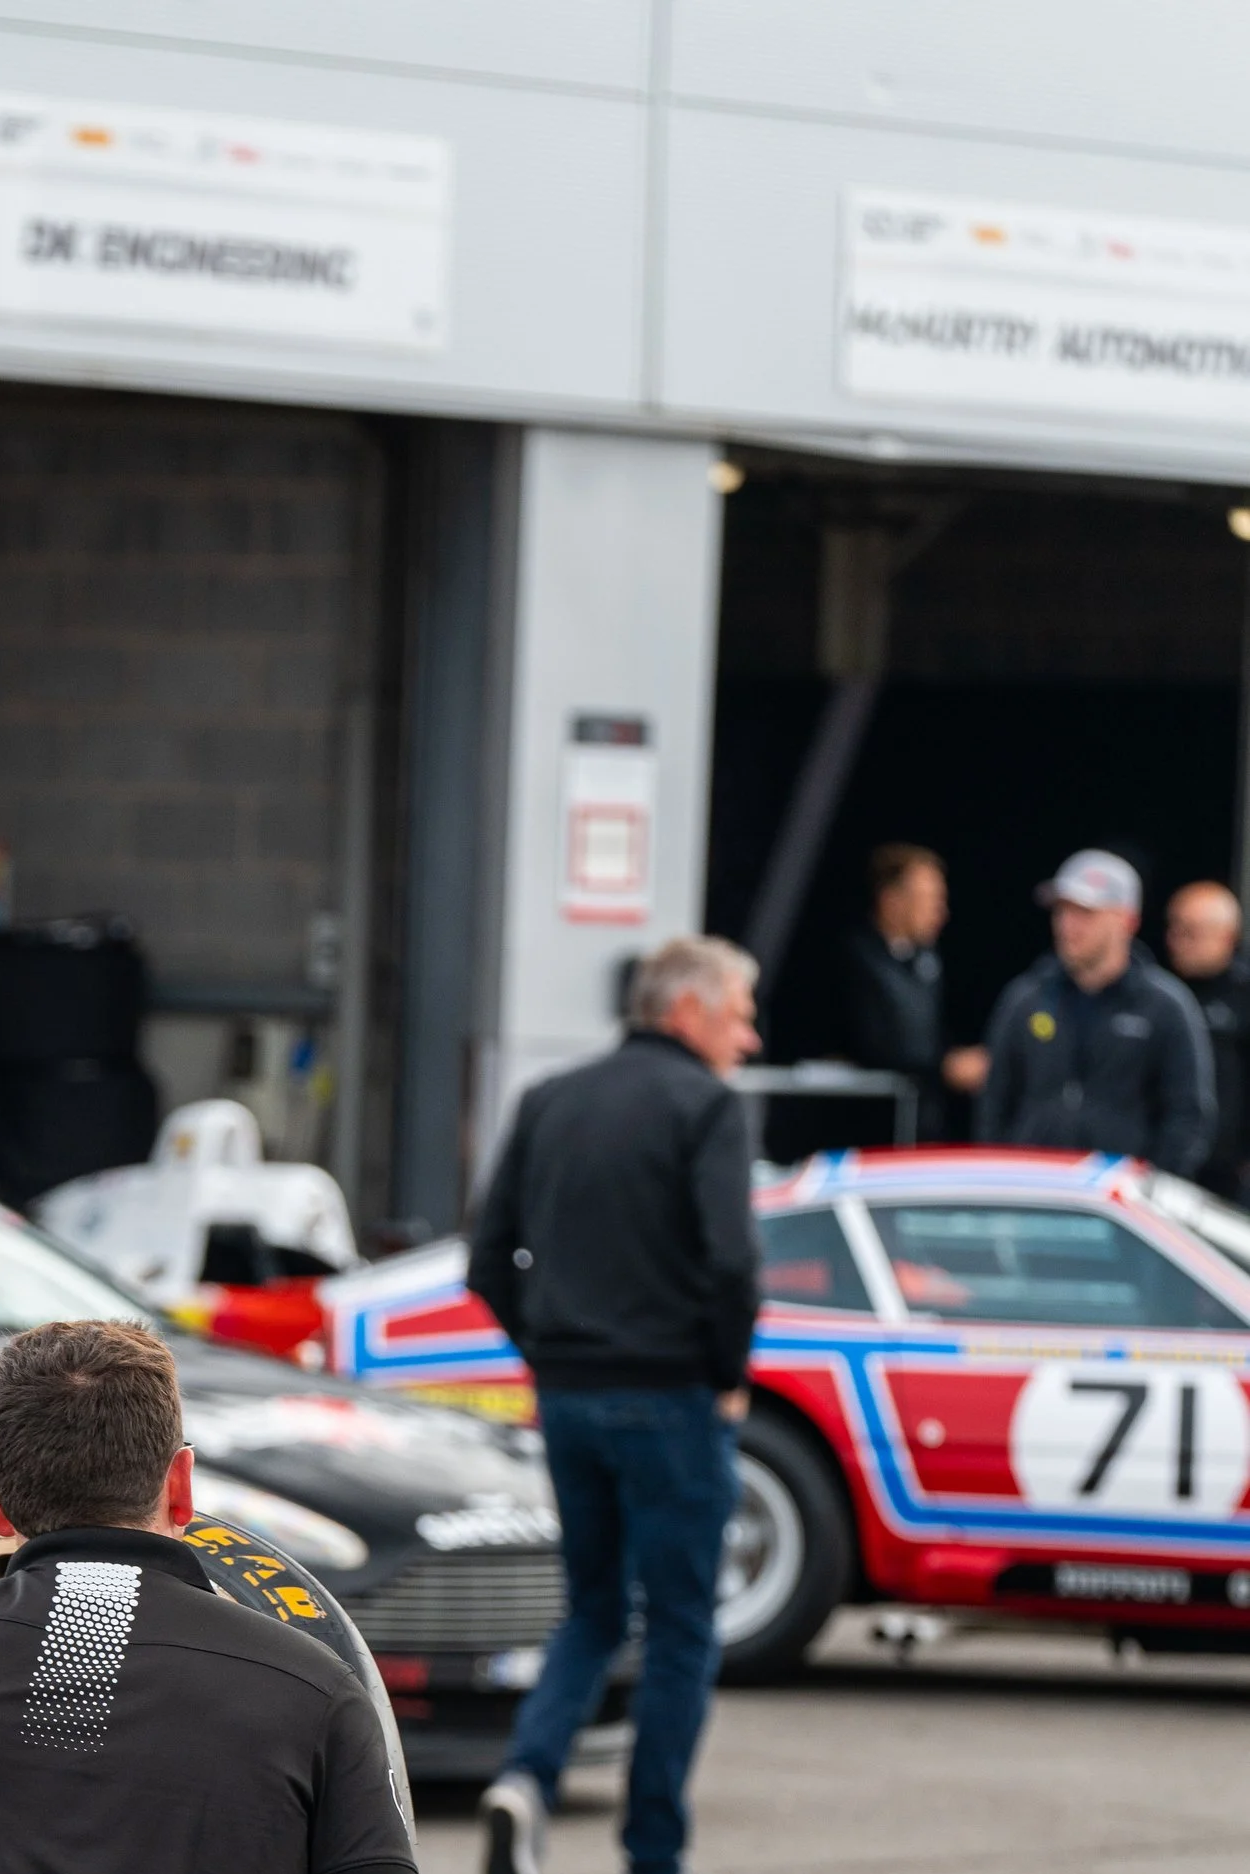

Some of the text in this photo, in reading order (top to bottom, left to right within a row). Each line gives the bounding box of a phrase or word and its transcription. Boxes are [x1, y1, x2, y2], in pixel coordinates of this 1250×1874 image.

[21, 218, 357, 291] DK ENGINEERING
[1068, 1380, 1198, 1502] 71
